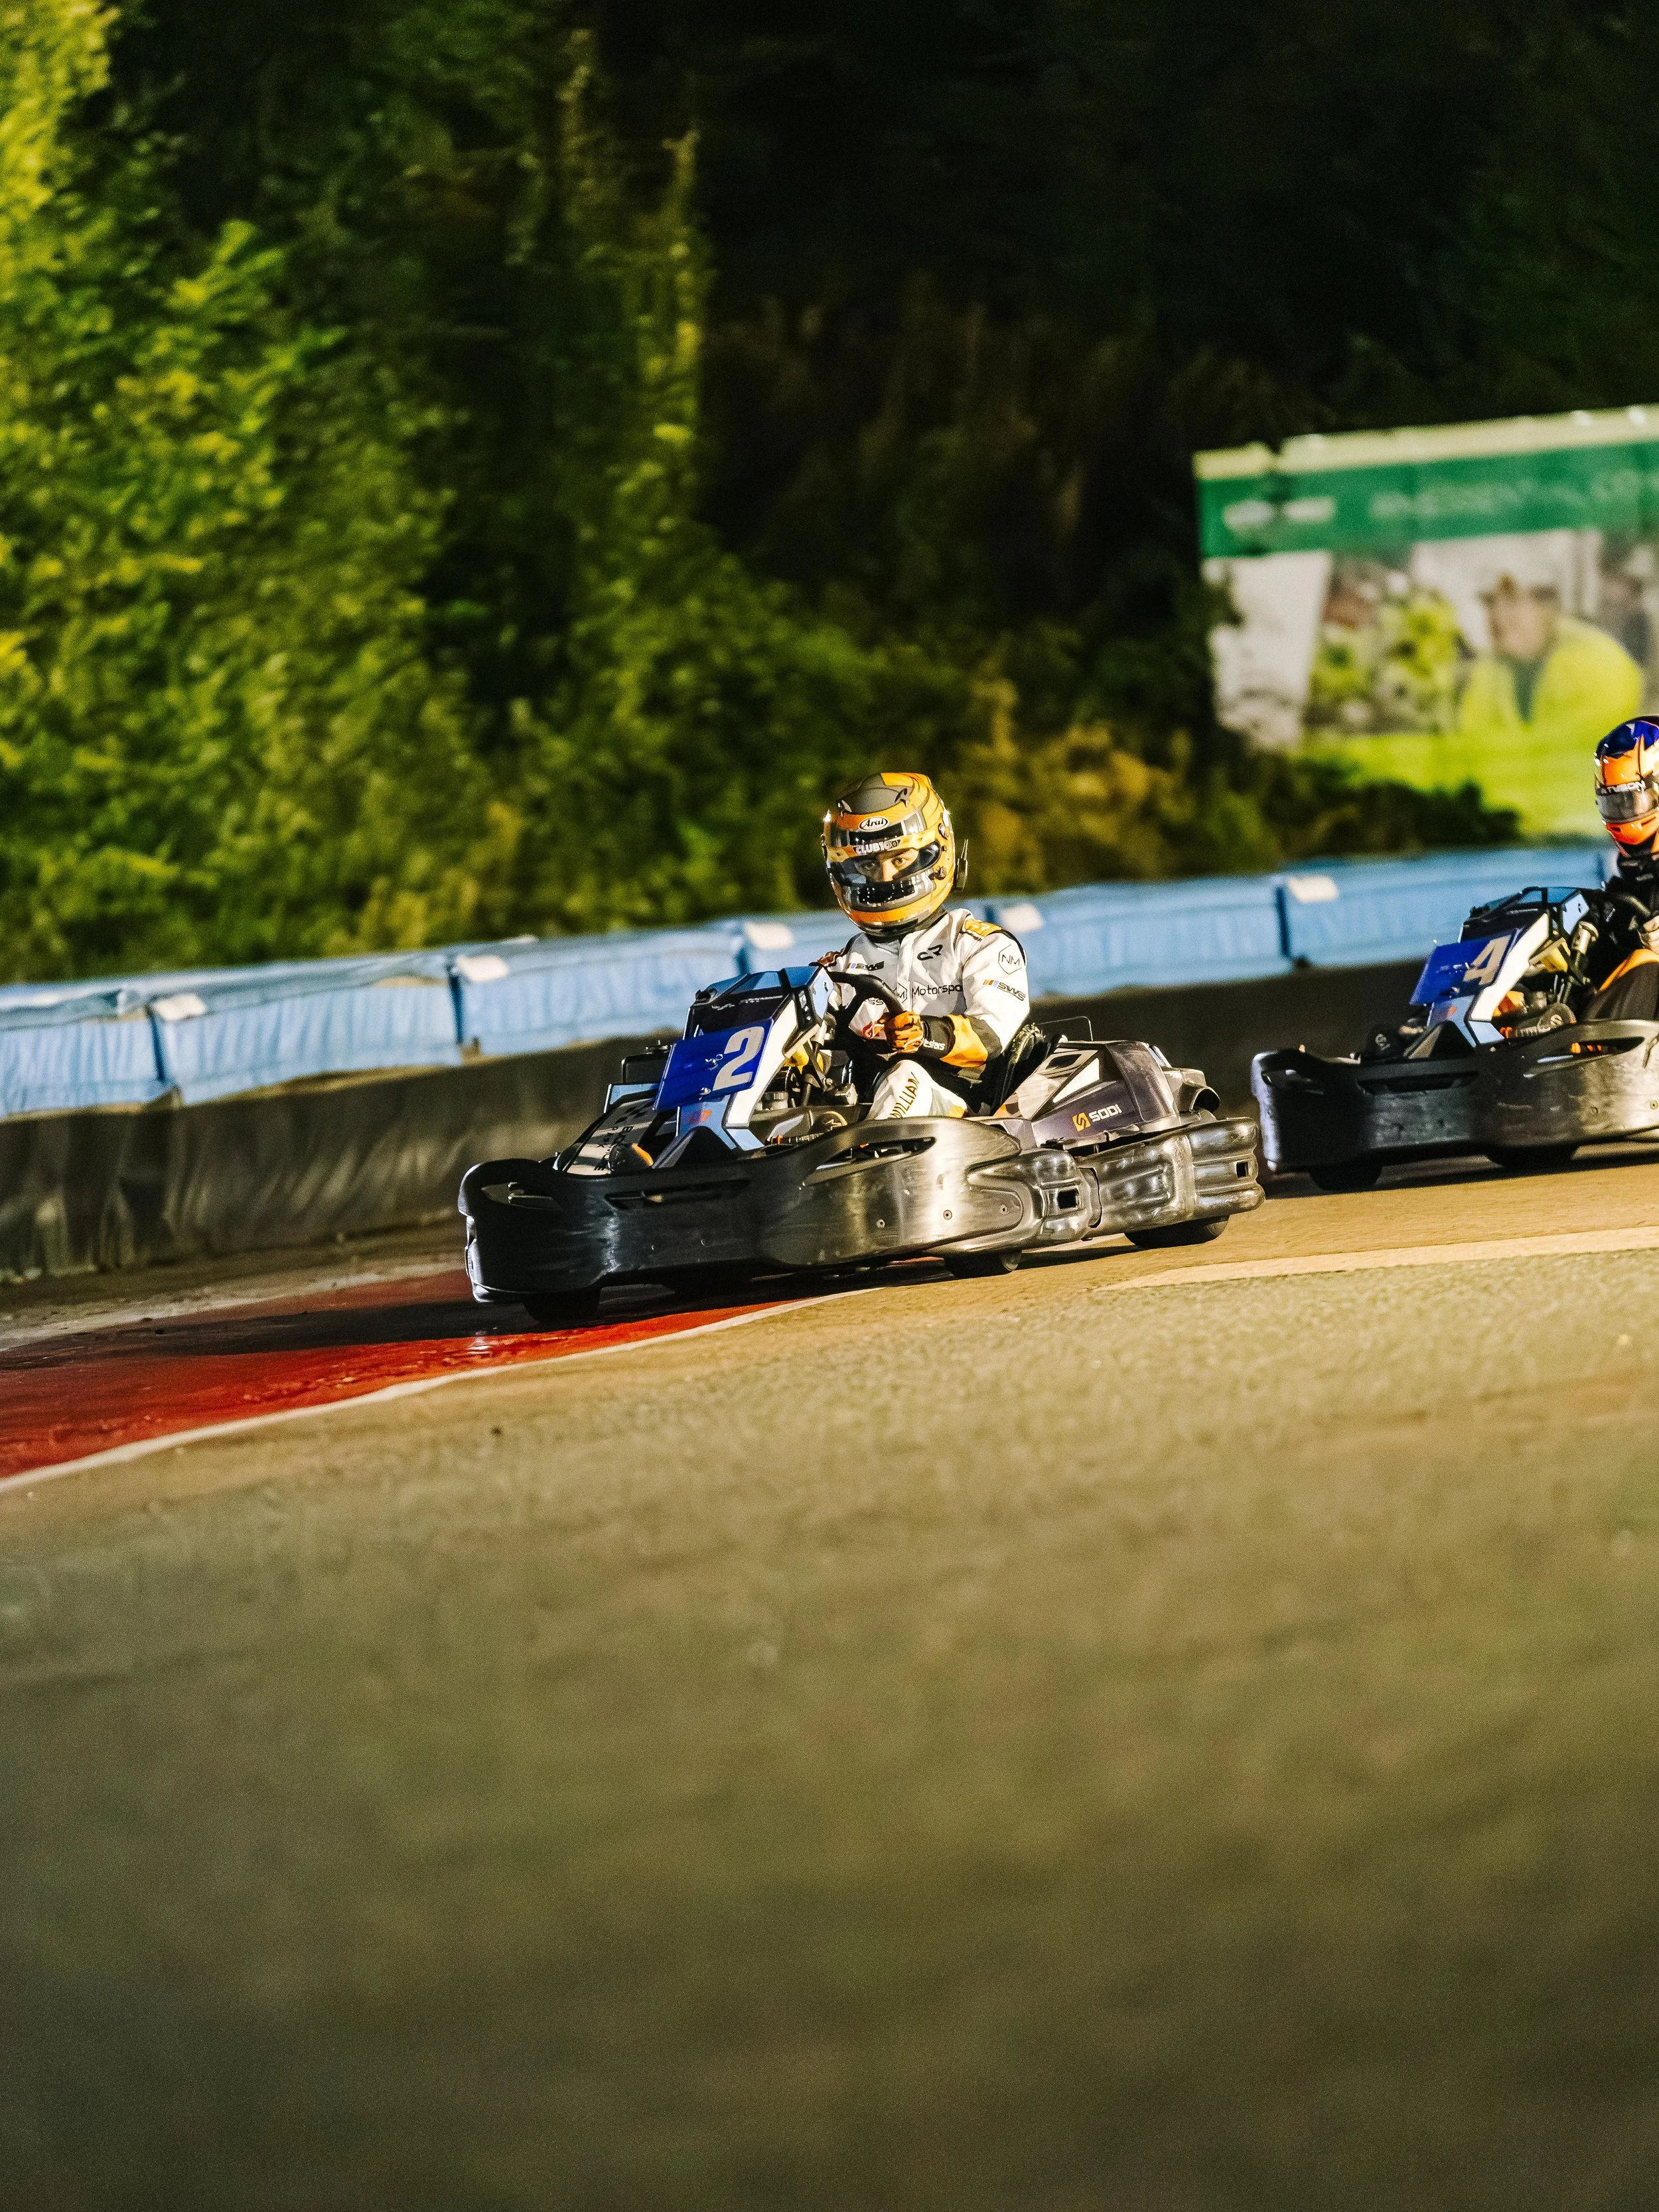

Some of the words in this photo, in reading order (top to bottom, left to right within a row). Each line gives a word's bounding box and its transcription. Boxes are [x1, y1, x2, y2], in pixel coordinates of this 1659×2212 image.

[863, 817, 884, 828] Arai
[1001, 954, 1021, 966] NM
[1463, 935, 1512, 985] 4
[997, 982, 1027, 1001] SWS
[712, 1026, 764, 1091] 2
[1088, 1104, 1122, 1122] SODI
